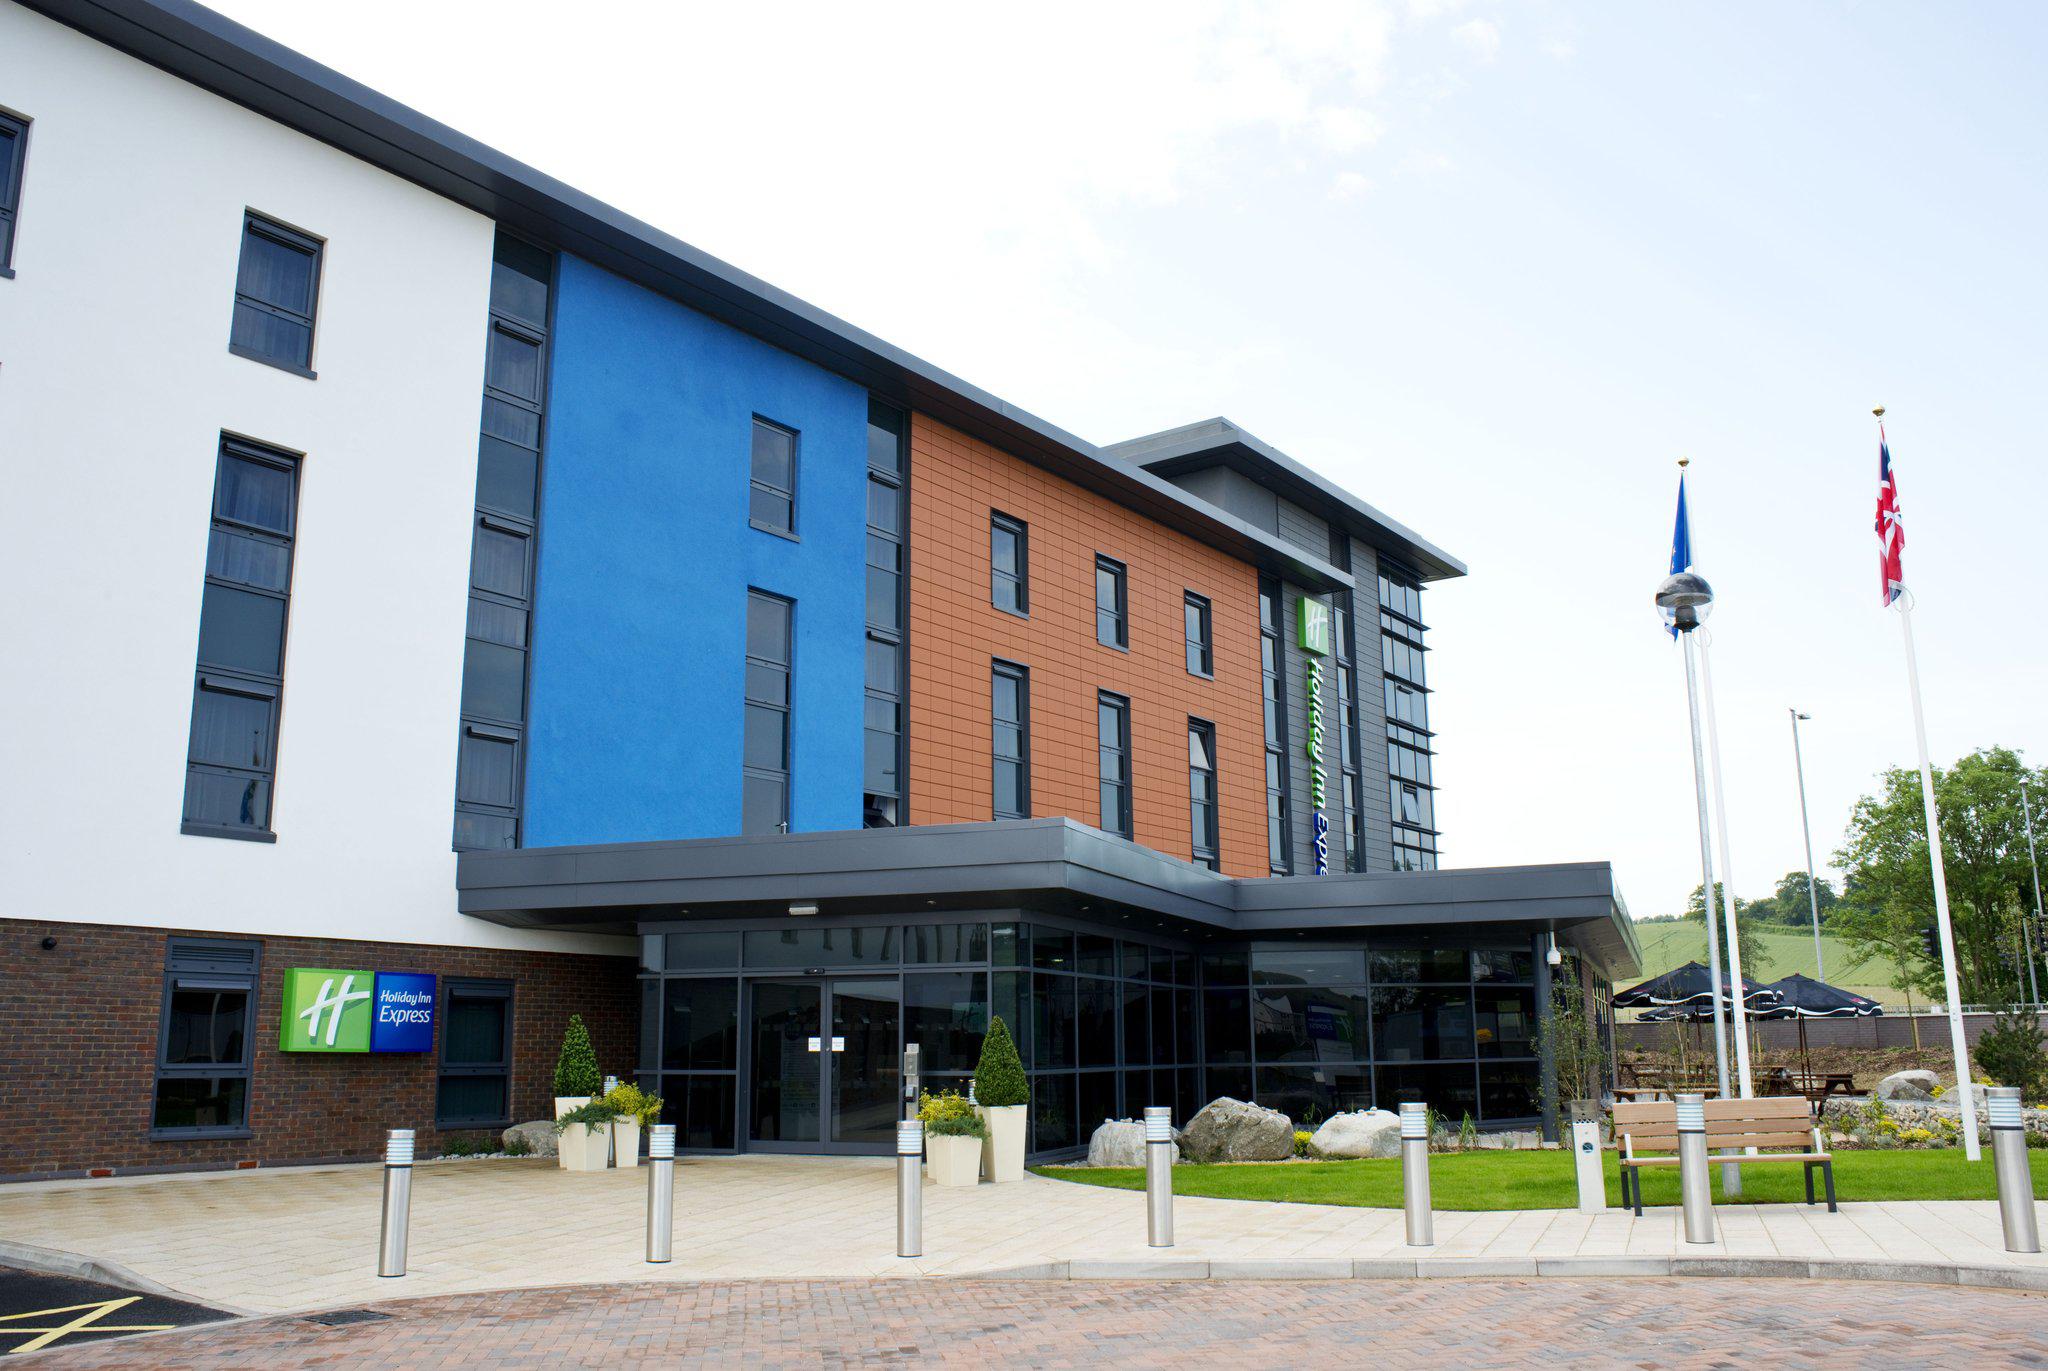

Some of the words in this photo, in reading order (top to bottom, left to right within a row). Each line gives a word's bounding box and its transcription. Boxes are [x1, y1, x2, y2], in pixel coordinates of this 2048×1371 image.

[1308, 657, 1326, 763] Holiday
[1313, 765, 1328, 809] Inn
[380, 990, 416, 1005] Holiday
[417, 991, 431, 1003] Inn
[379, 1005, 430, 1026] Express
